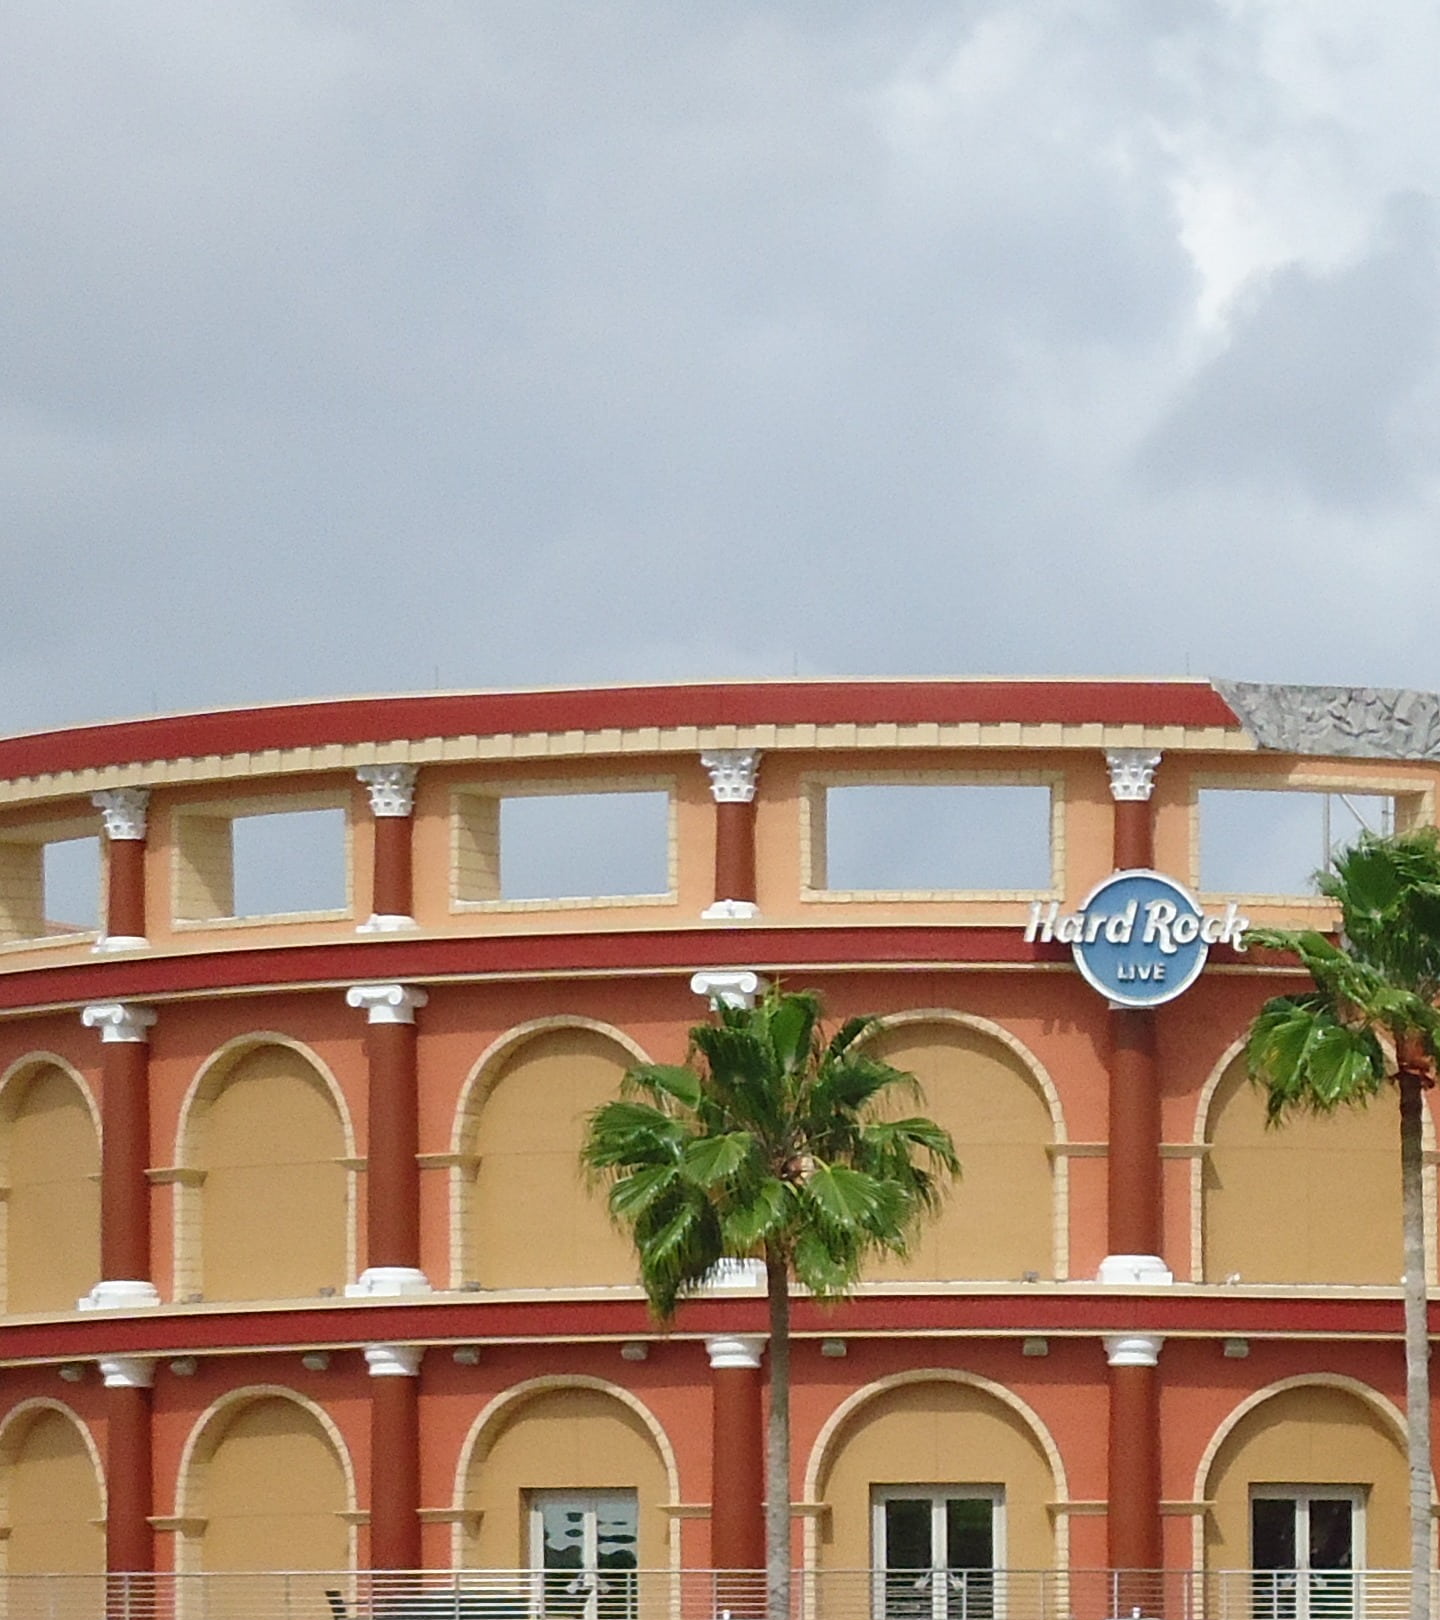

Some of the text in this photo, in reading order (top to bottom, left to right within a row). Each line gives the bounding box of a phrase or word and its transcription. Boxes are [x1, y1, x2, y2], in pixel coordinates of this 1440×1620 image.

[1023, 899, 1250, 954] Hard Rock
[1116, 962, 1167, 981] LIVE
